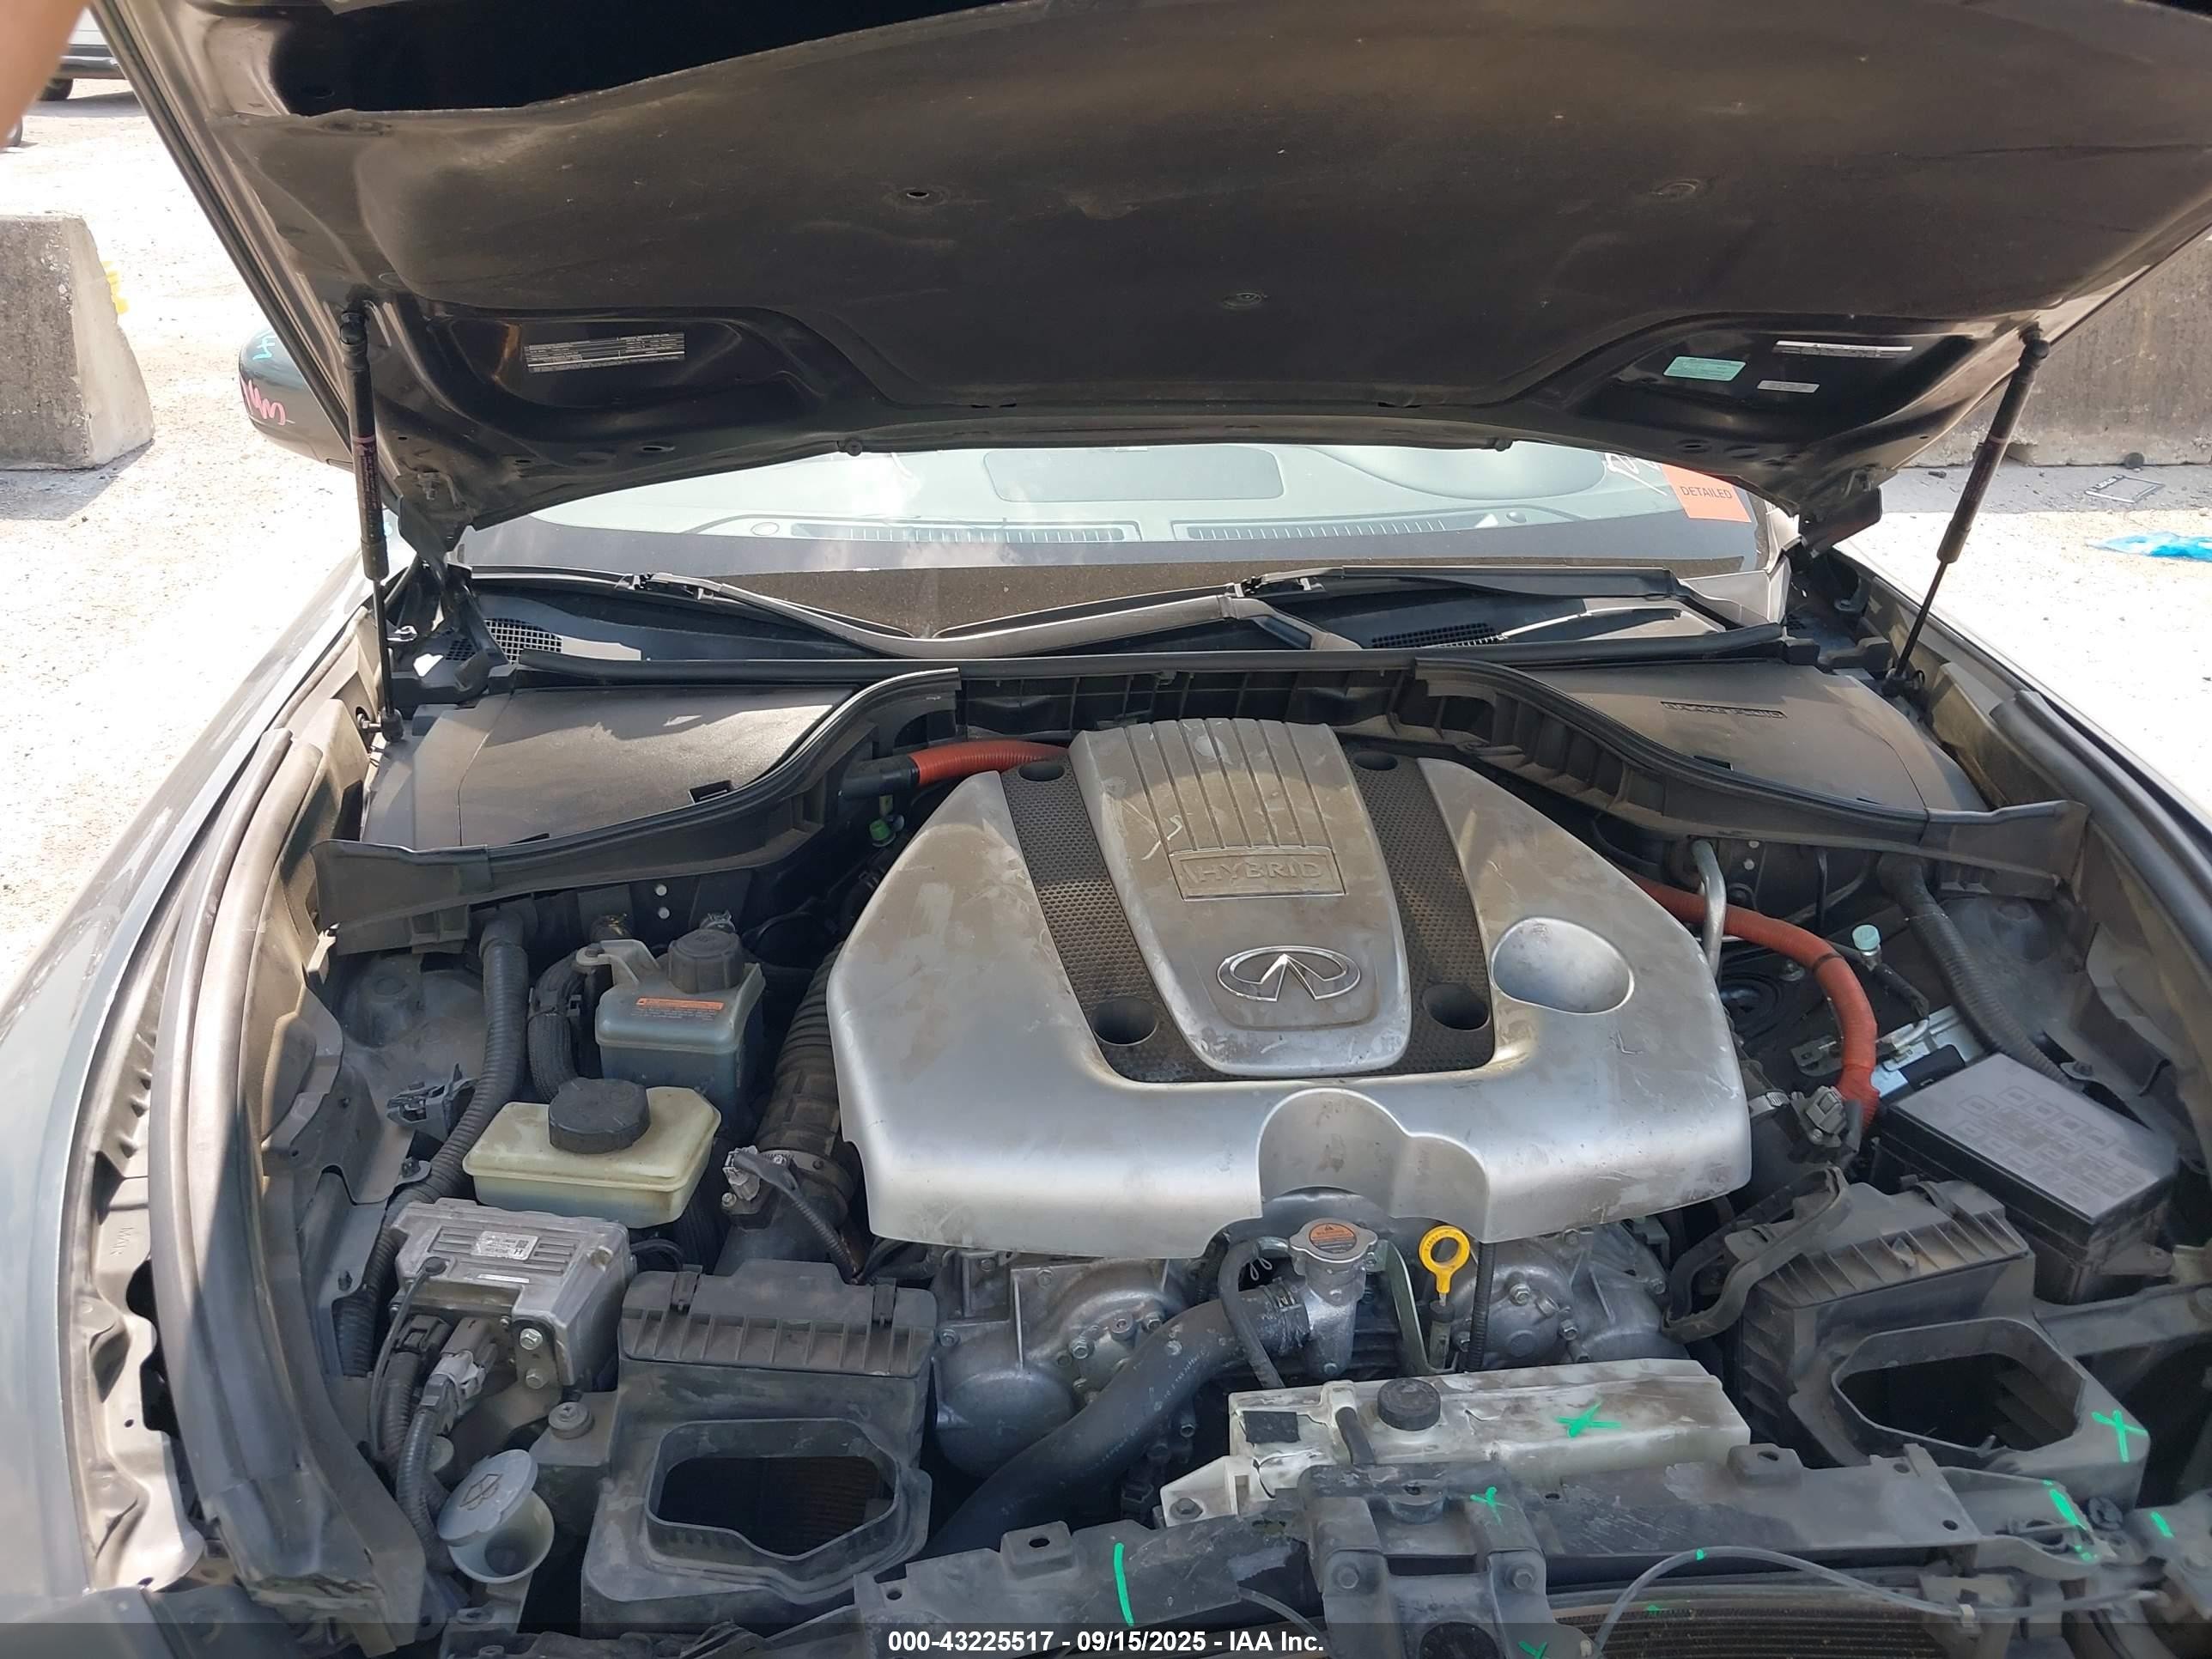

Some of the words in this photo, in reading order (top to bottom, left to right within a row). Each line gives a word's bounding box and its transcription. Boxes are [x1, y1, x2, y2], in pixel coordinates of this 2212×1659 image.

[1680, 486, 1733, 500] DETAILED
[1664, 703, 1727, 714] BRAKE
[1197, 861, 1322, 883] HYBRID
